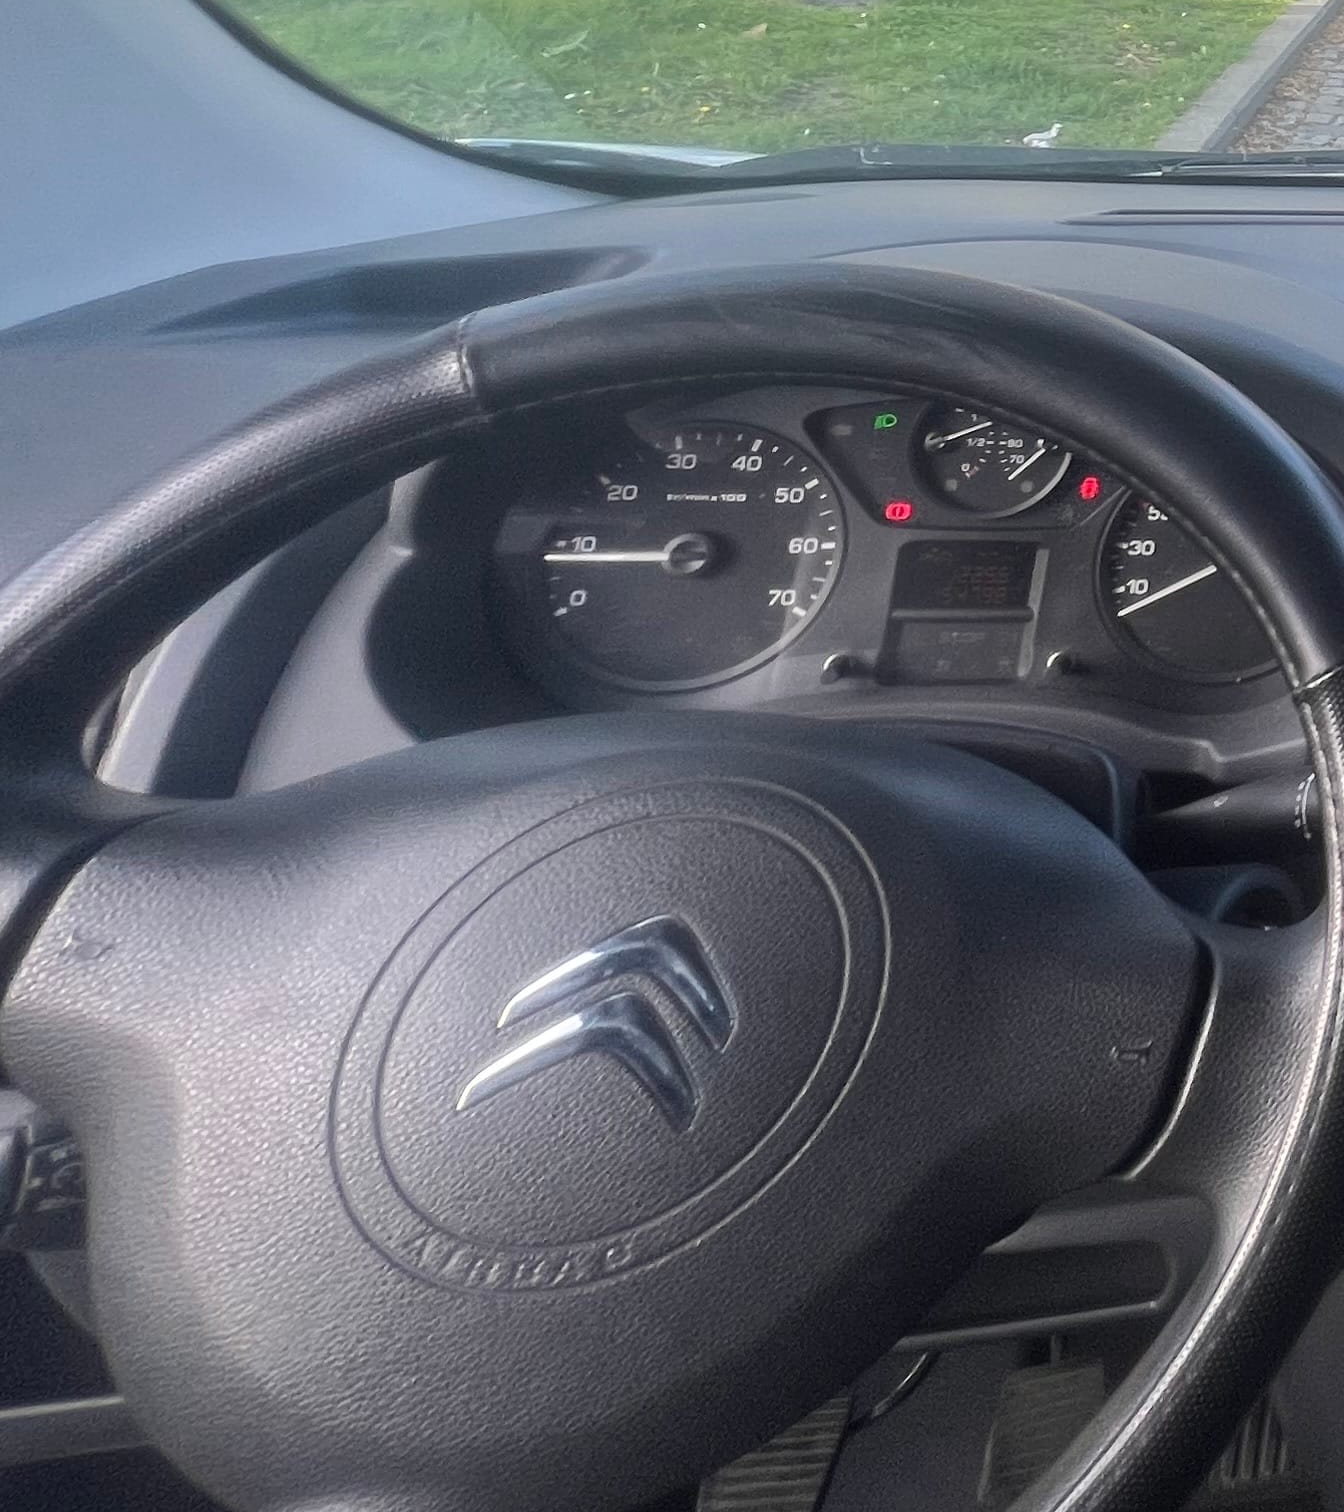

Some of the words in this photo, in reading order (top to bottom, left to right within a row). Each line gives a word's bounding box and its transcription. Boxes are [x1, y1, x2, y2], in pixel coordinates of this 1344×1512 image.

[665, 454, 697, 470] 30
[732, 455, 763, 472] 40
[1009, 454, 1025, 464] 70
[607, 484, 638, 502] 20
[720, 493, 747, 502] 100
[775, 487, 805, 504] 50
[572, 536, 596, 552] 10
[788, 538, 819, 554] 60
[1127, 540, 1155, 557] 30
[1126, 578, 1149, 595] 10
[569, 589, 587, 607] 0
[768, 589, 796, 607] 70
